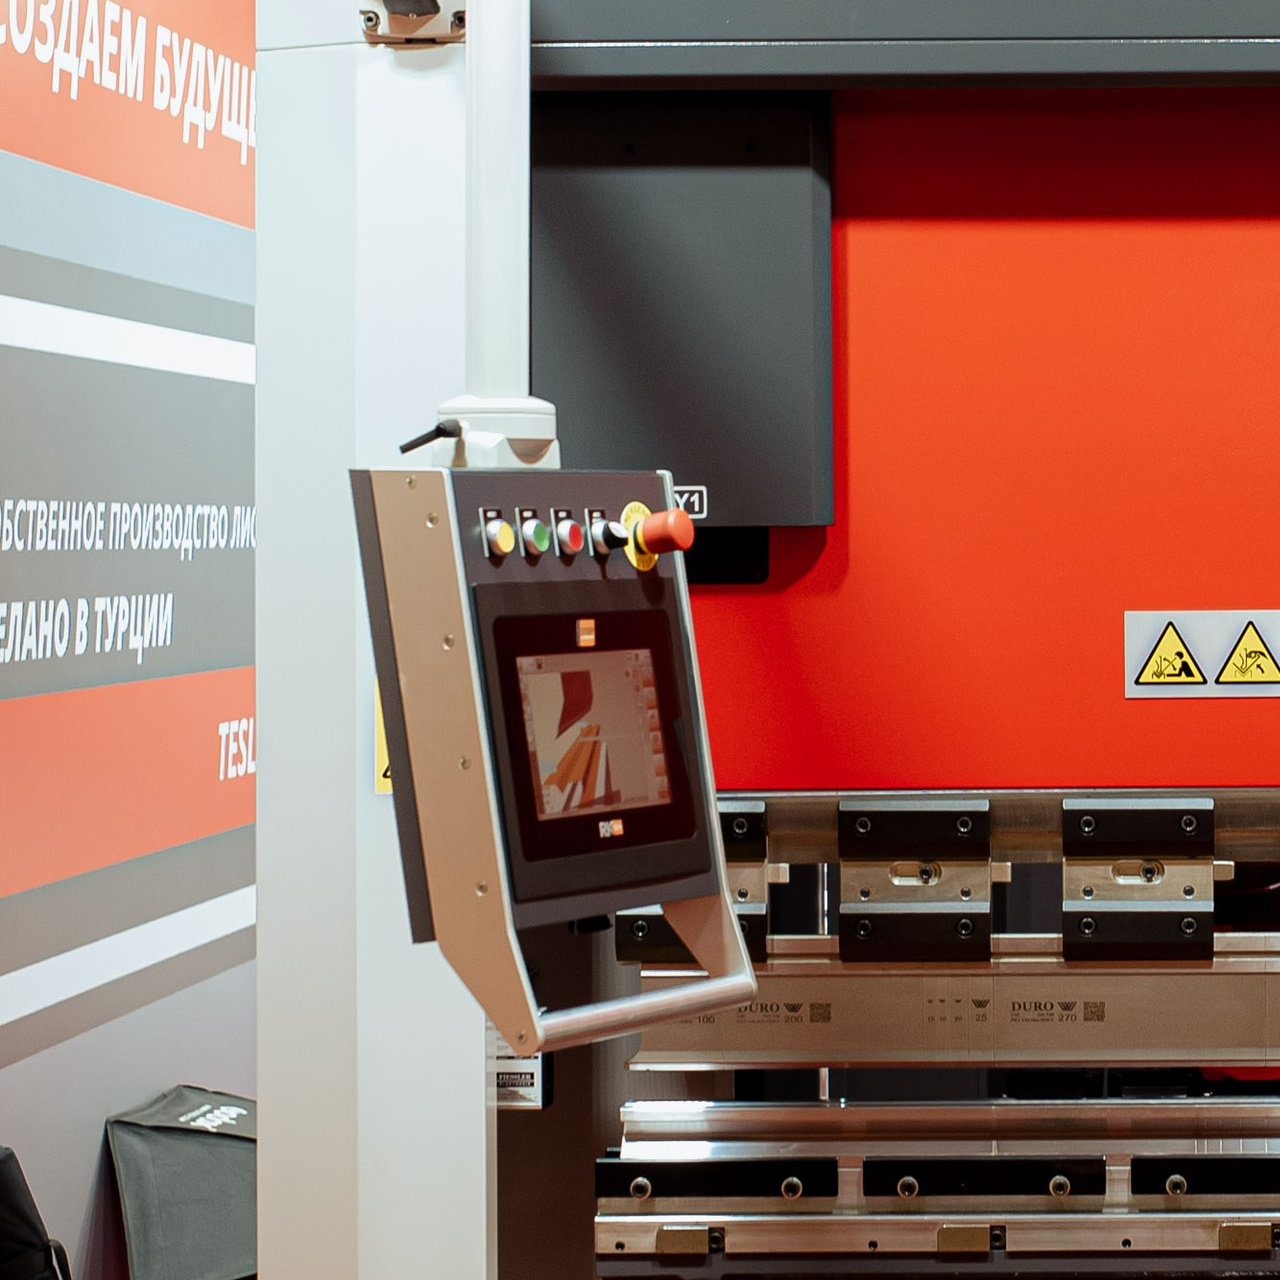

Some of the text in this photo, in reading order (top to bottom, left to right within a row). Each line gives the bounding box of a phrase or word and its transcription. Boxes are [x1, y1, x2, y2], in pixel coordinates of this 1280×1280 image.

[0, 499, 106, 552] БСТВЕННОЕ
[108, 502, 229, 562] ПРОИЗВОДСТВО
[674, 492, 700, 513] Y1
[75, 597, 89, 656] В
[94, 592, 174, 665] ТУРЦИИ
[218, 717, 256, 782] TESL
[1011, 1001, 1054, 1013] DURO
